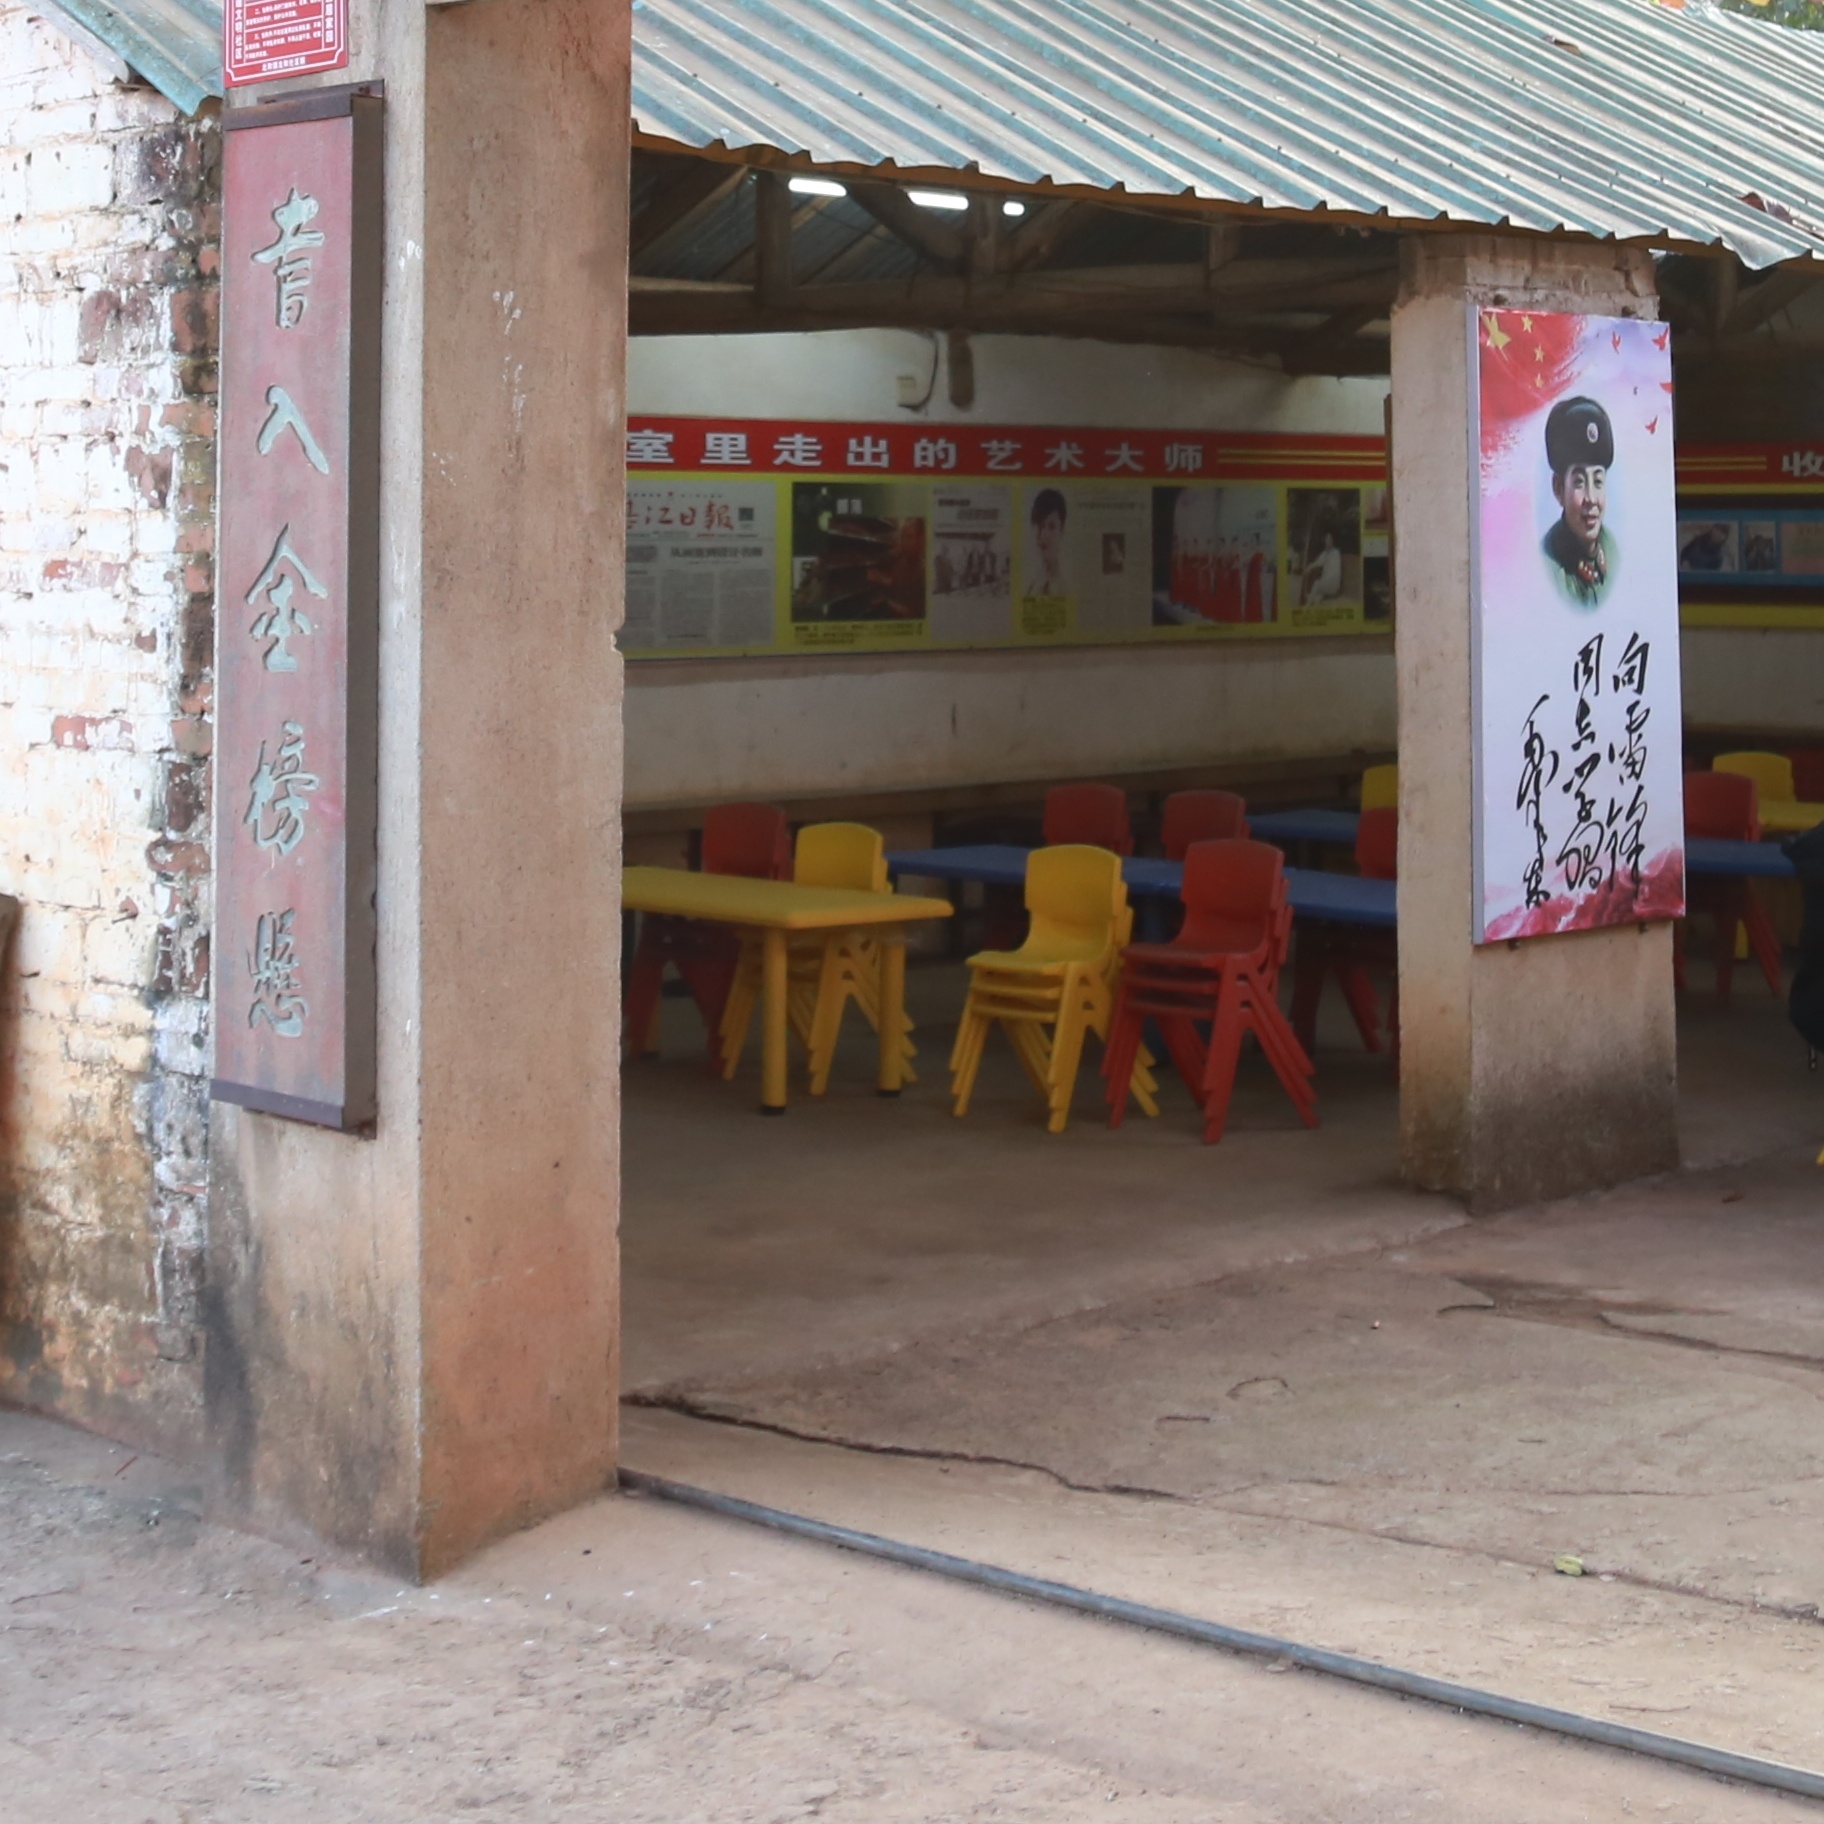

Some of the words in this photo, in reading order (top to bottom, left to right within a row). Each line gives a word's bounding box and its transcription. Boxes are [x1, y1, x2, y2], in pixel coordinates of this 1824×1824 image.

[626, 430, 1203, 473] 室里走出的艺术大师
